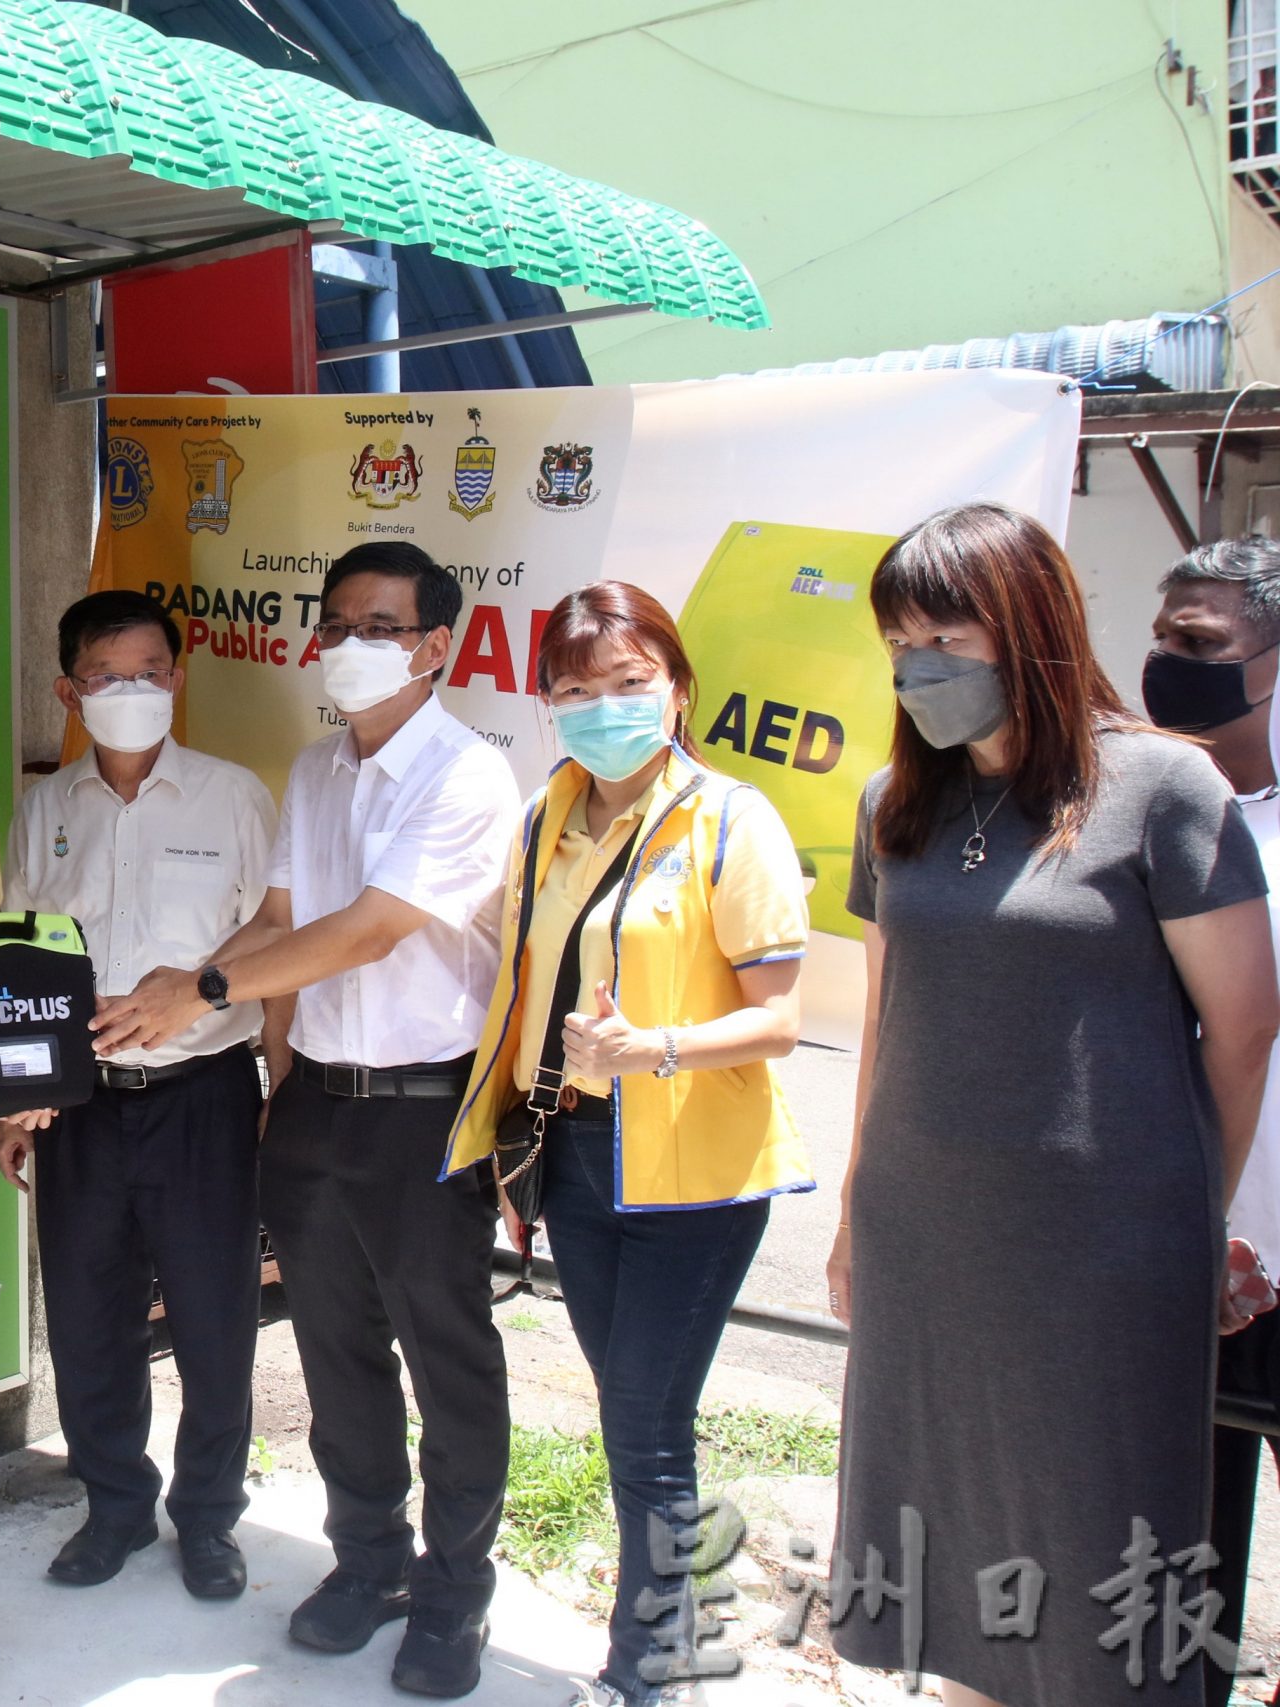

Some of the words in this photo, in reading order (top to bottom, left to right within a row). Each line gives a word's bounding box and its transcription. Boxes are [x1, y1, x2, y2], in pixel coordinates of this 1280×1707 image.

[131, 416, 183, 429] Community
[186, 416, 208, 427] Care
[210, 415, 247, 429] Project
[248, 415, 261, 429] by
[344, 411, 414, 428] Supported
[416, 410, 434, 427] by
[109, 440, 142, 461] IONS
[112, 466, 133, 497] L
[347, 522, 371, 532] Bukit
[374, 523, 415, 534] Bendera
[242, 548, 335, 574] Launchi
[497, 562, 525, 586] of
[798, 566, 824, 578] ZOLL
[186, 618, 289, 666] Public
[703, 692, 845, 775] AED
[165, 847, 184, 855] CHOW
